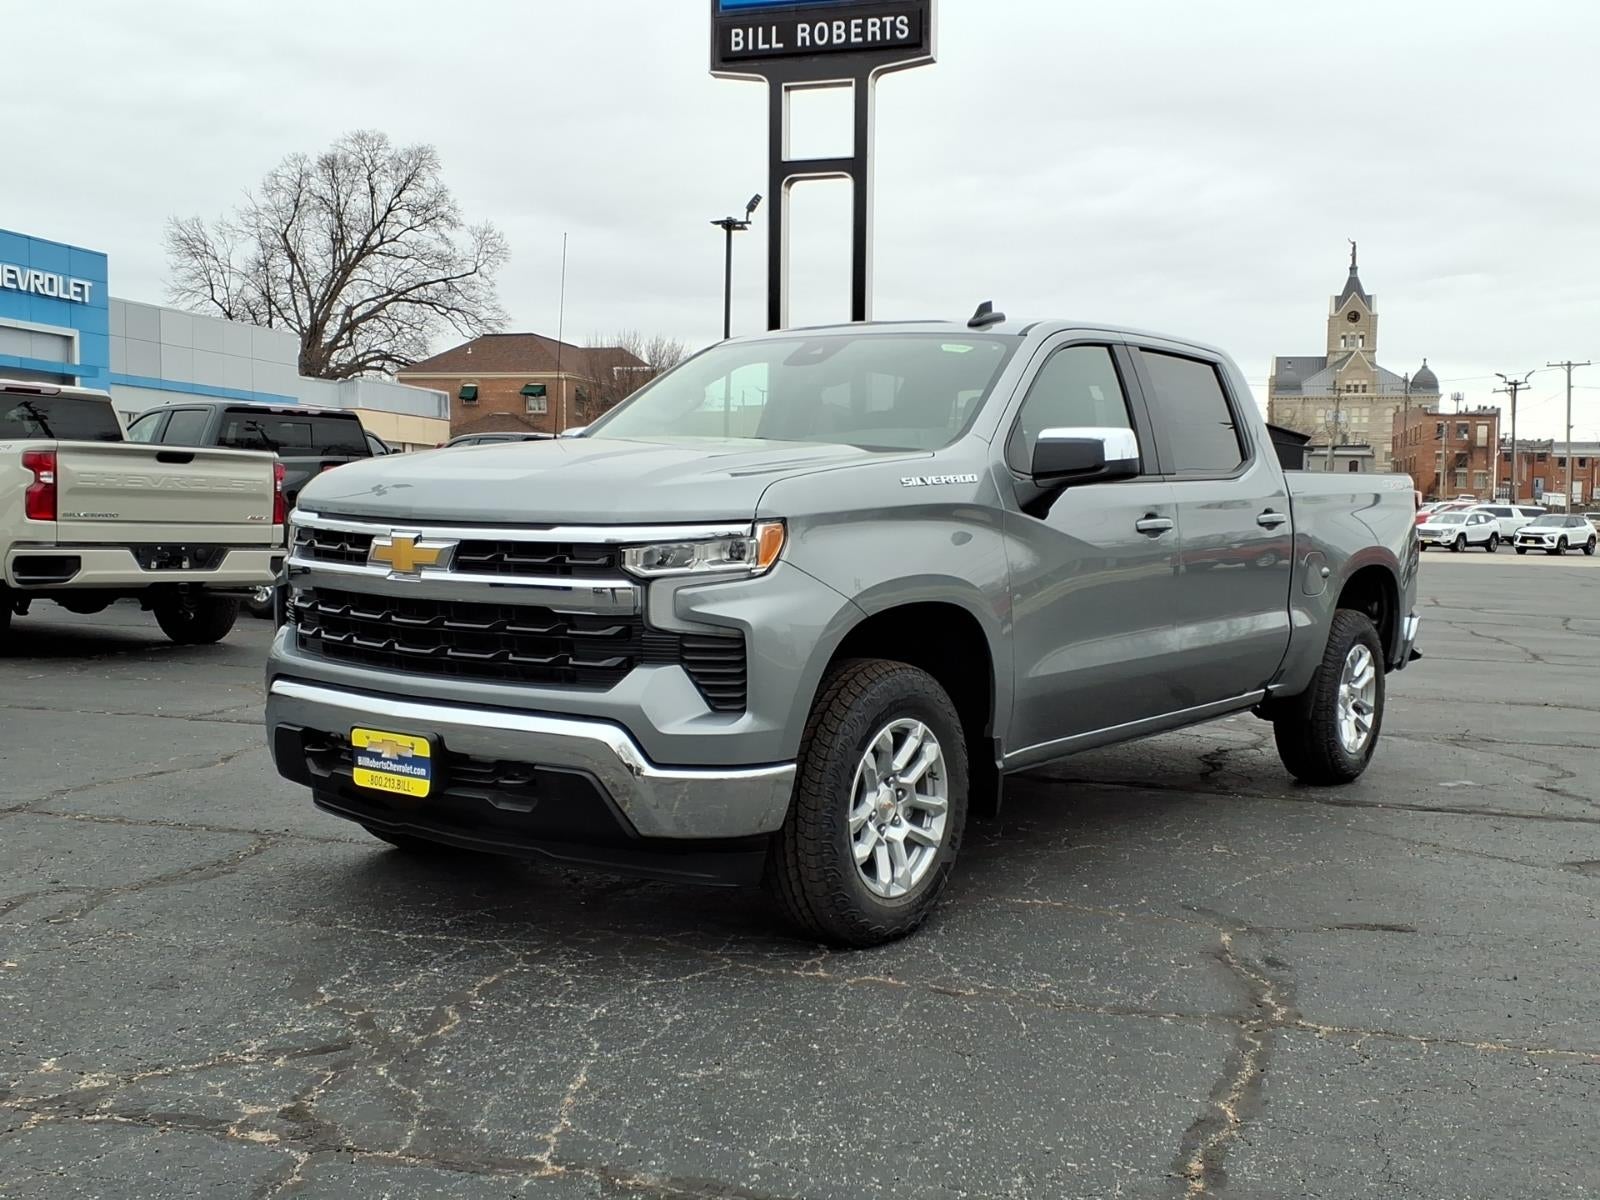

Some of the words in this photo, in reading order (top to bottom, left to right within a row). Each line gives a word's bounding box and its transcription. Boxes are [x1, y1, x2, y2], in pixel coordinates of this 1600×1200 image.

[731, 26, 783, 51] BILL
[797, 15, 910, 47] ROBERTS
[0, 264, 92, 303] EVROLET
[77, 471, 264, 492] CHEVROLET
[901, 473, 978, 487] SILVERADO
